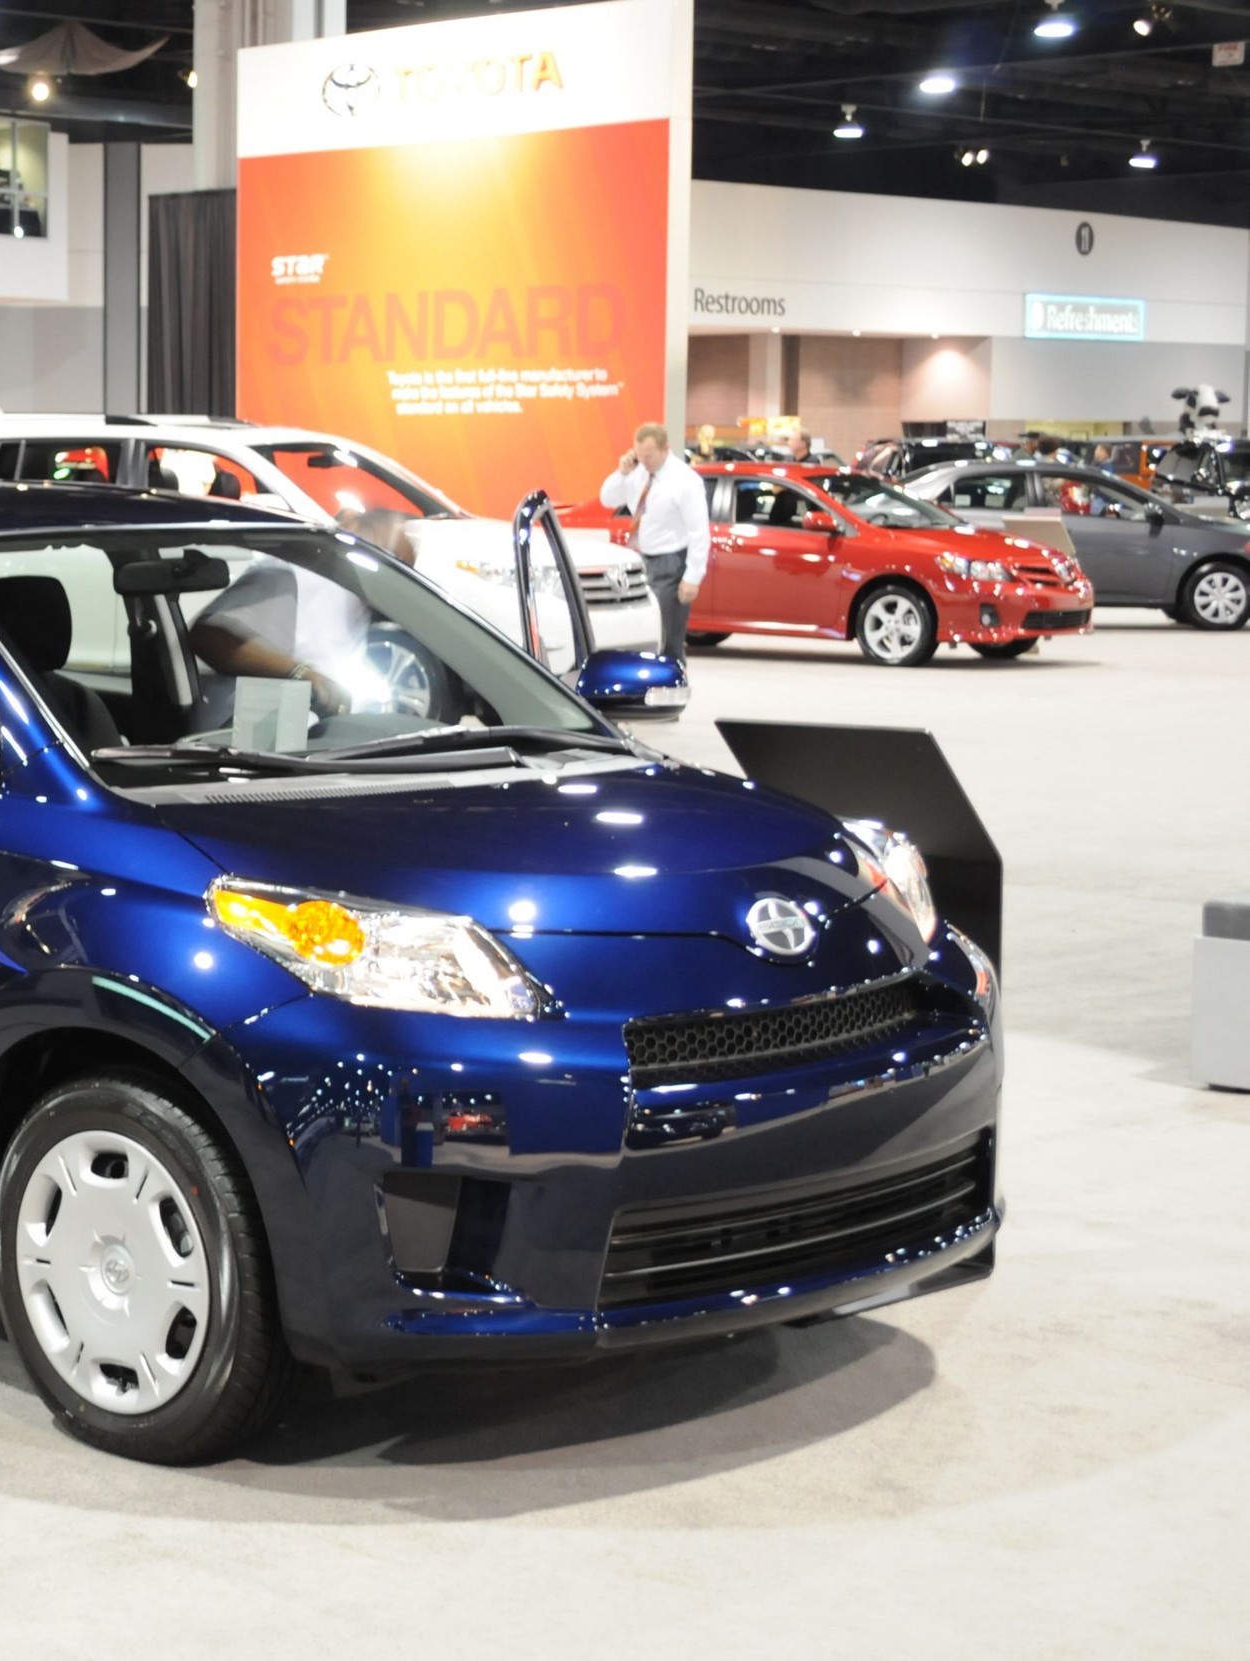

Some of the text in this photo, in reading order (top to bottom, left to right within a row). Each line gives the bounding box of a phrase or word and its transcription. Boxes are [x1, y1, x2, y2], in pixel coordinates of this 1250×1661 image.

[395, 51, 564, 102] TOOTA
[693, 287, 786, 317] Restrooms
[1046, 304, 1139, 333] Refreshments
[269, 284, 626, 366] STANDARD
